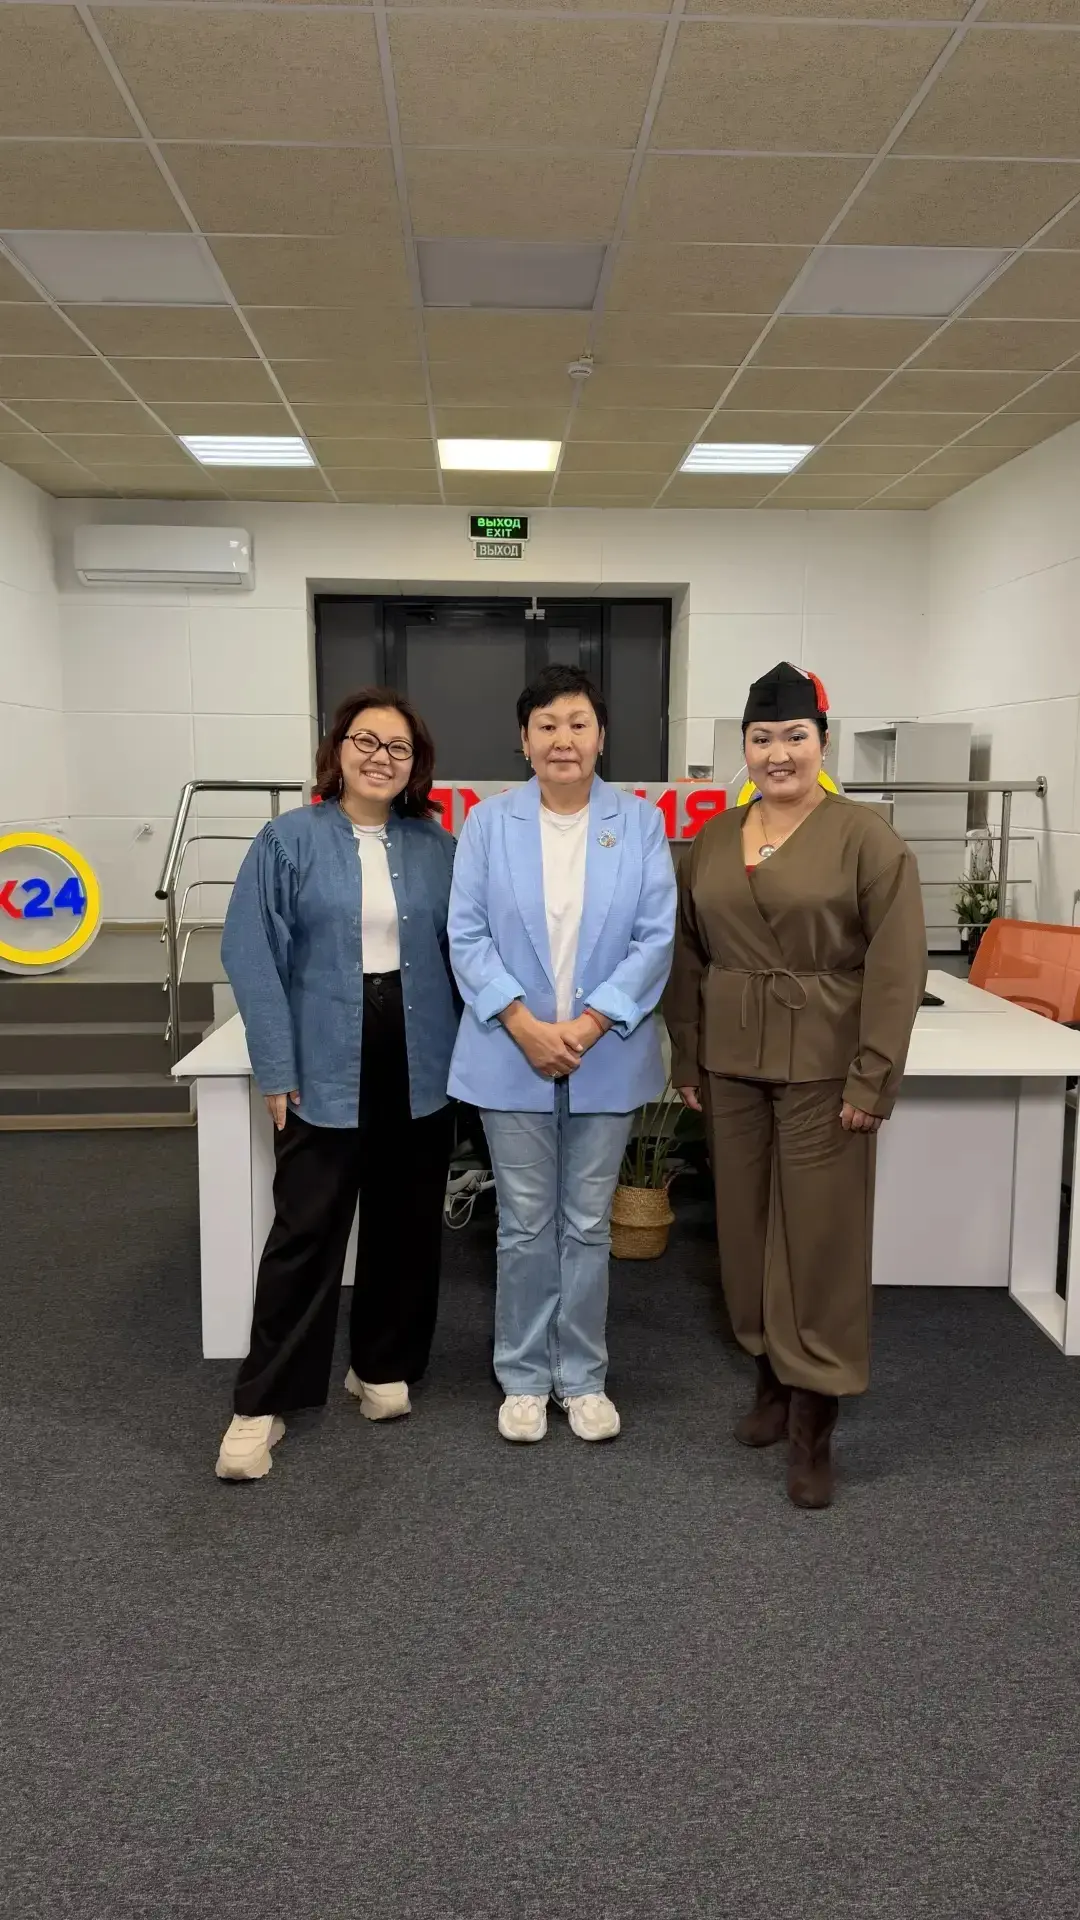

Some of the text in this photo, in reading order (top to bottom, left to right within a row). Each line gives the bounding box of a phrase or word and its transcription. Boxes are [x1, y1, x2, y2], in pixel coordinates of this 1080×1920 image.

[477, 517, 521, 529] ВЫХОД
[486, 528, 513, 537] EXIT
[479, 545, 519, 557] ВЫХОД
